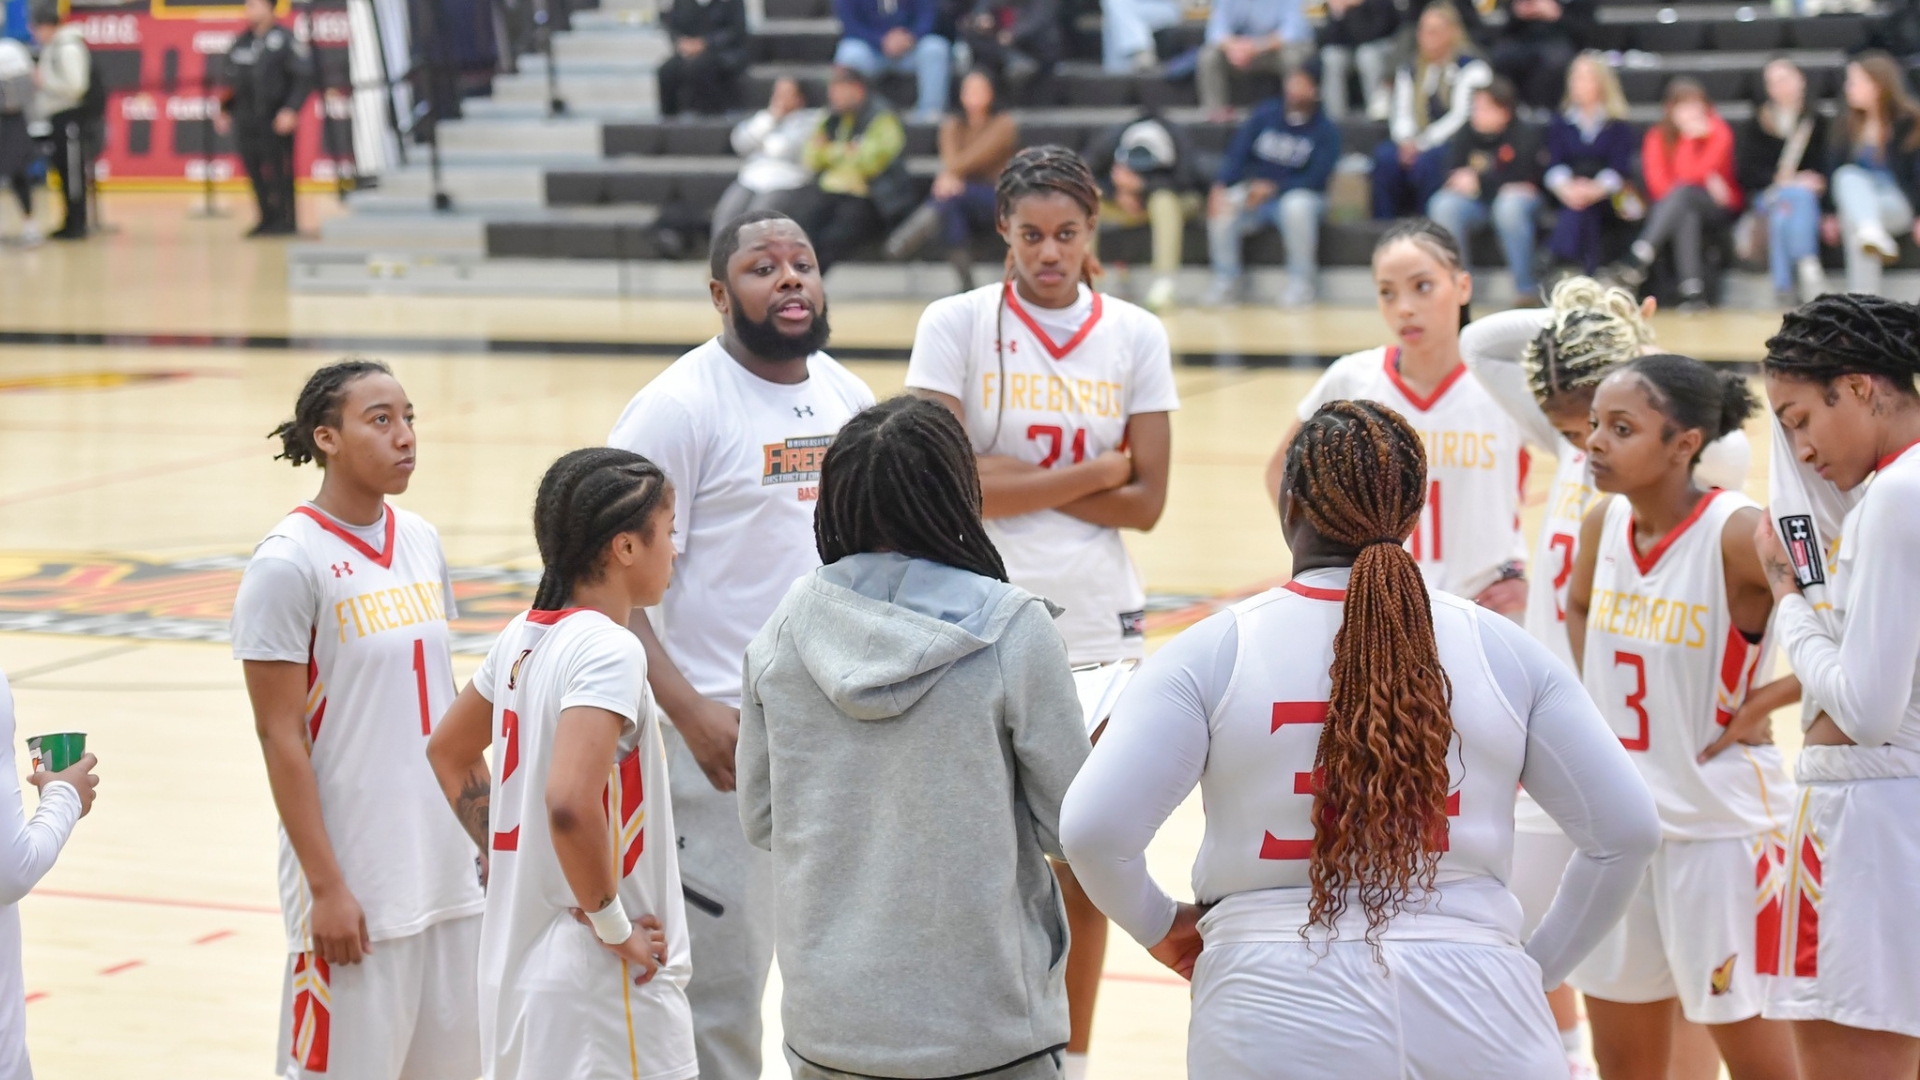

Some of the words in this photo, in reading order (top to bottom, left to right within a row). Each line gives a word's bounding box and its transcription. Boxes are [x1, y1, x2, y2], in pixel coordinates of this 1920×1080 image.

[982, 371, 1122, 418] FIREBIRDS
[413, 638, 431, 737] 1
[1614, 650, 1650, 753] 3
[492, 708, 521, 851] 2
[1258, 701, 1460, 860] 3
